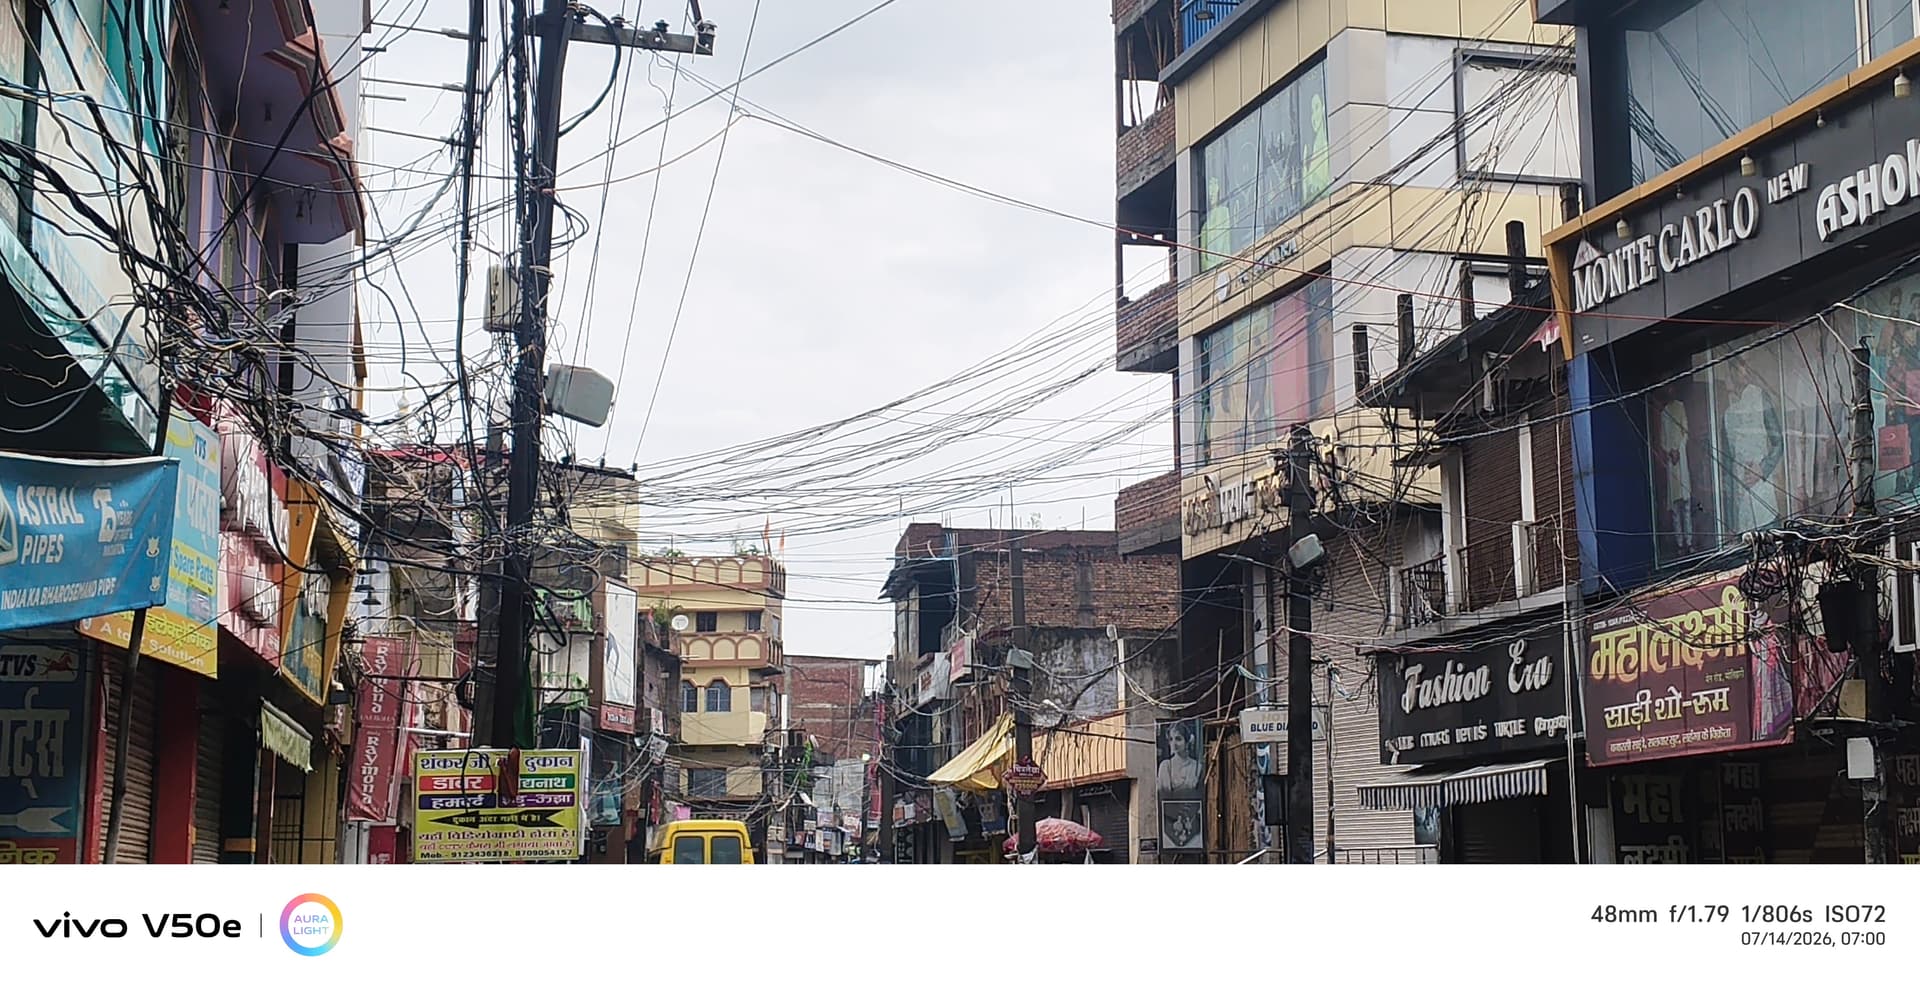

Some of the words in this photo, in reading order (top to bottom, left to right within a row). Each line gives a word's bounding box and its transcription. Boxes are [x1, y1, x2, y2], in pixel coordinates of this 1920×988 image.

[1767, 163, 1809, 204] NEW
[1572, 234, 1658, 313] MONTE
[1658, 186, 1759, 273] CARLO
[16, 485, 85, 526] ASTRAL
[20, 533, 65, 565] PIPES
[1, 589, 27, 611] INDIA
[27, 587, 40, 608] KA
[100, 621, 112, 636] A
[149, 638, 204, 667] Solution
[0, 655, 37, 677] TVS
[1401, 658, 1493, 714] Fashion
[1507, 638, 1553, 694] Era
[1250, 723, 1274, 732] BLUE
[1603, 689, 1653, 731] साड़ी
[360, 736, 379, 805] Raymond
[525, 756, 574, 773] दुकान
